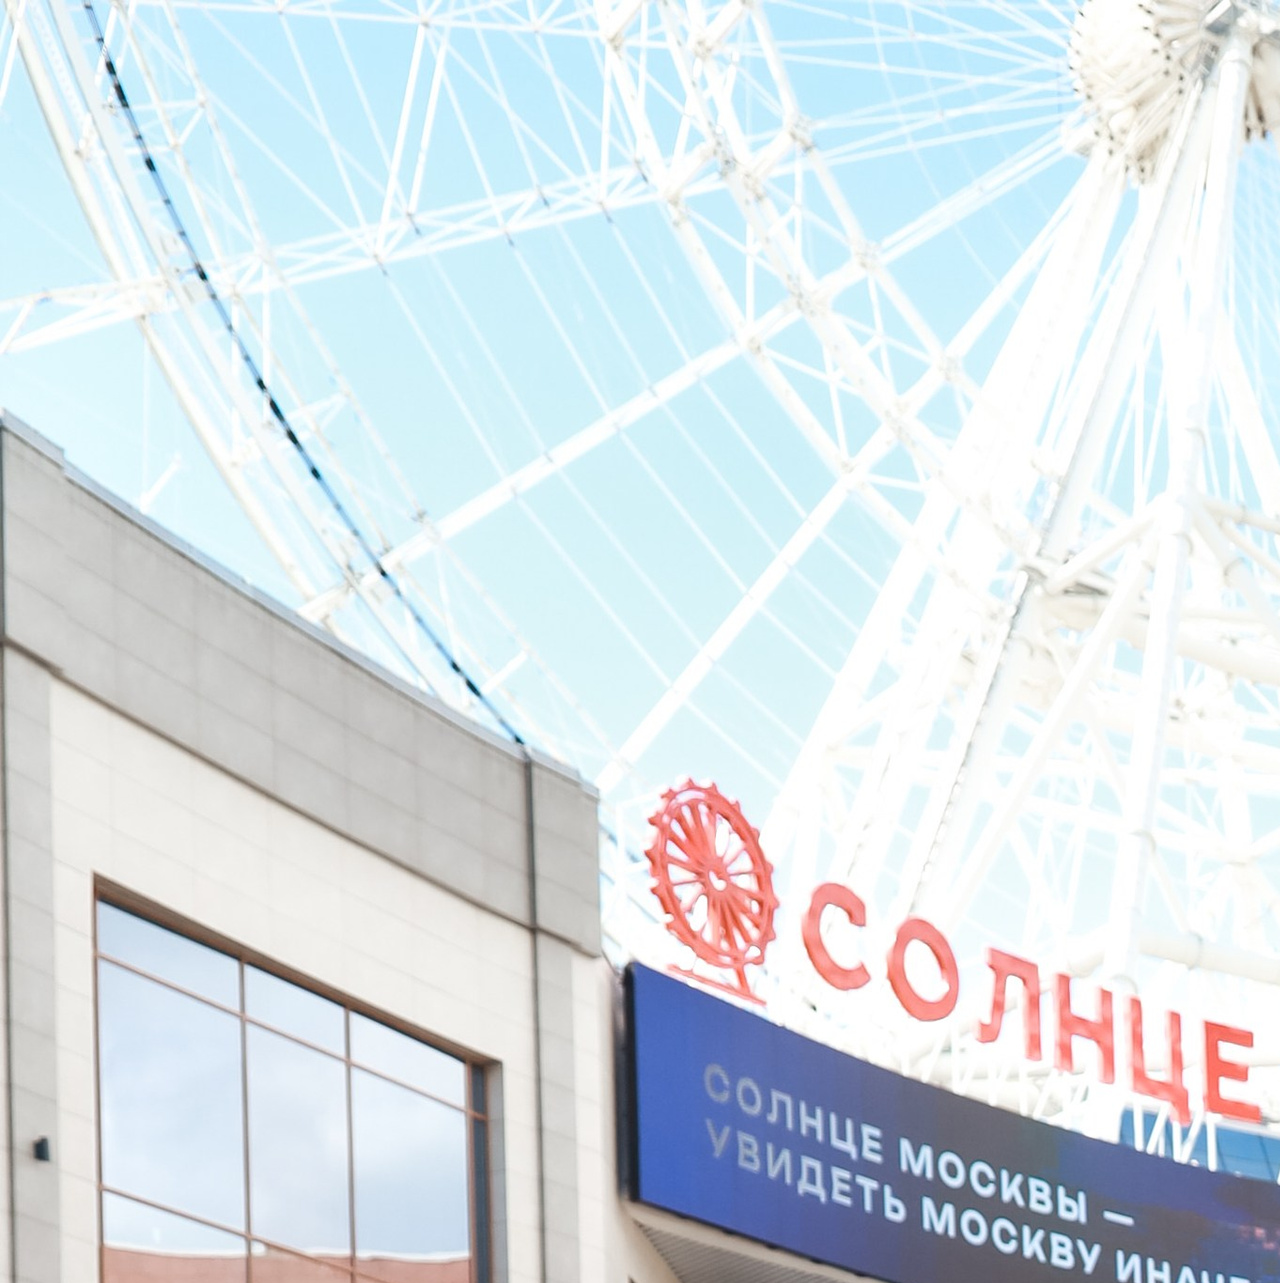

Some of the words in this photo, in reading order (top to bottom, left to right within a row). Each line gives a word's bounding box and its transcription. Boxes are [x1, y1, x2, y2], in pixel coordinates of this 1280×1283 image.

[803, 882, 1261, 1125] СОЛНЦЕ
[704, 1063, 884, 1165] СОЛНЦЕ
[900, 1136, 1088, 1224] МОСКВЫ
[704, 1117, 906, 1223] УВИДЕТЬ
[921, 1196, 1102, 1275] МОСКВУ
